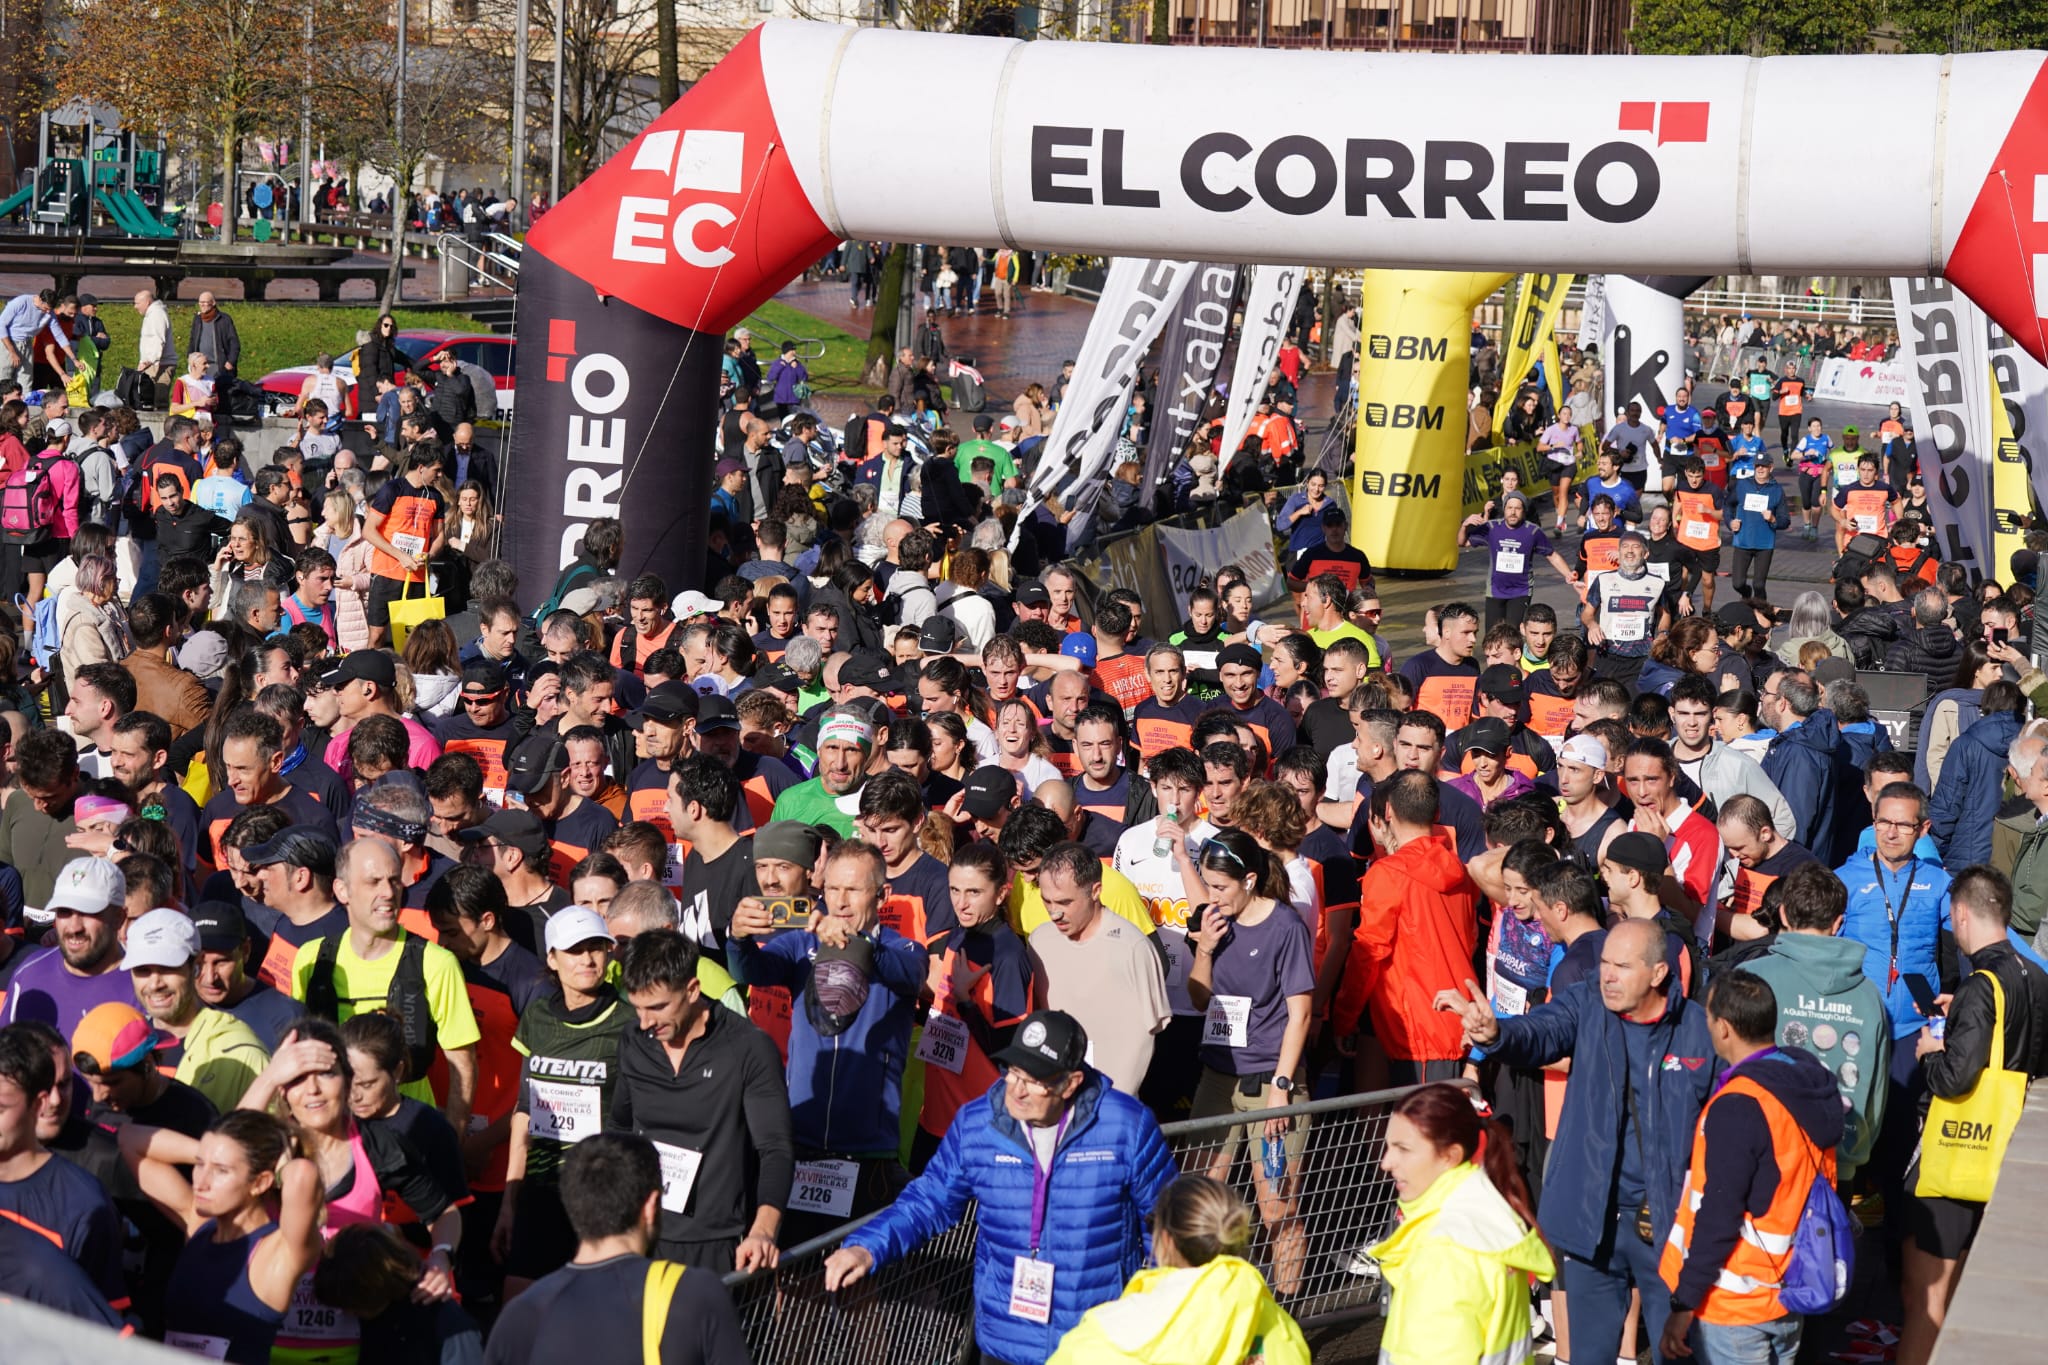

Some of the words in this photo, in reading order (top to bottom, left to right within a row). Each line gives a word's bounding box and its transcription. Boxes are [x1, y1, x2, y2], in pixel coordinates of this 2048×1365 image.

[1032, 125, 1160, 208] EL
[1180, 132, 1661, 224] CORREO
[612, 196, 737, 268] EC
[1395, 336, 1448, 362] BM
[1391, 404, 1445, 431] BM
[1388, 473, 1441, 499] BM
[1798, 994, 1816, 1010] La
[1819, 997, 1853, 1015] Lune
[1211, 1022, 1234, 1036] 2046
[932, 1040, 955, 1062] 3279
[550, 1114, 575, 1131] 229
[1958, 1120, 1993, 1142] BM
[800, 1184, 832, 1204] 2126
[296, 1310, 335, 1327] 1246
